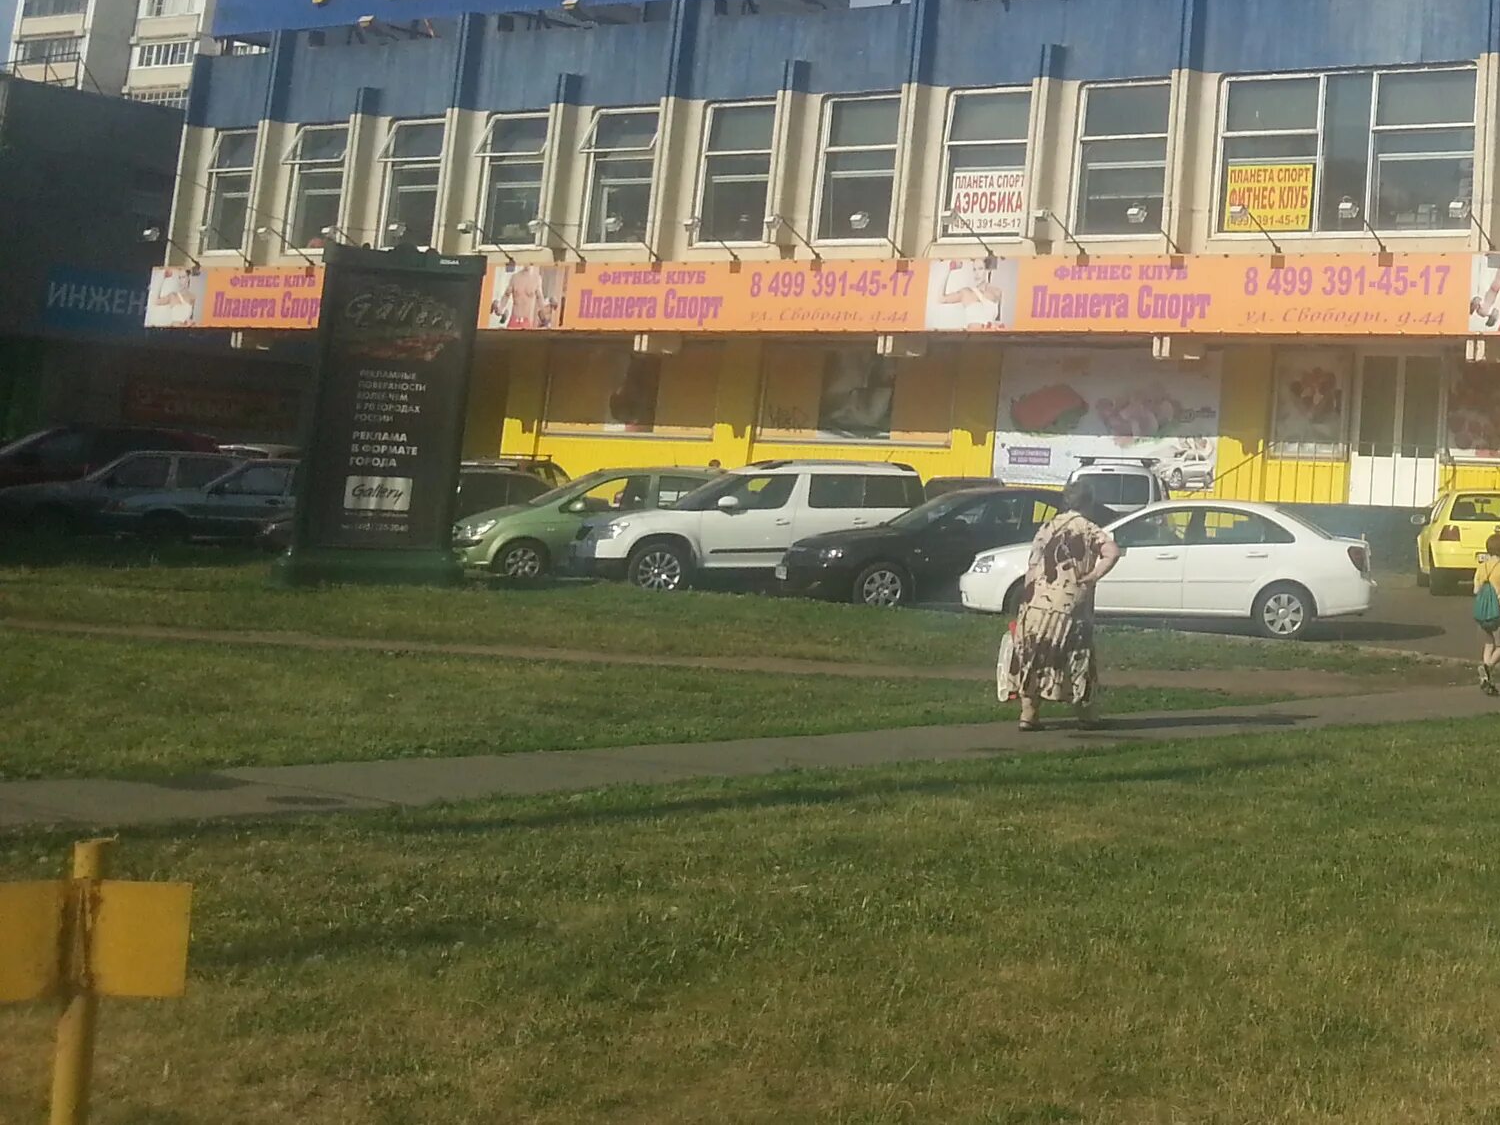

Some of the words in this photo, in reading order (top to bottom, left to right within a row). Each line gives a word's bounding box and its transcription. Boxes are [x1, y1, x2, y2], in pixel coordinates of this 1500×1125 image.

[955, 175, 995, 189] ПЛАНЕТА
[996, 174, 1025, 188] СПОРТ
[1230, 168, 1275, 183] ПЛАНЕТА
[1277, 168, 1310, 182] СПОРТ
[954, 191, 1023, 214] АЭРОБИКА
[1229, 186, 1276, 210] ФИТНЕС
[1278, 186, 1309, 209] КЛУБ
[976, 218, 1022, 229] 391-45-17
[1256, 214, 1307, 226] 391-45-17
[230, 274, 280, 288] ФИТНЕС
[283, 274, 317, 288] КЛУБ
[598, 270, 660, 285] ФИТНЕС
[665, 270, 706, 285] КЛУБ
[1053, 264, 1132, 281] ФИТНЕС
[1138, 264, 1188, 281] КЛУБ
[1243, 266, 1259, 296] 8
[1266, 266, 1313, 296] 499
[1321, 265, 1451, 296] 391-45-17
[750, 271, 762, 298] 8
[768, 271, 806, 298] 499
[811, 270, 914, 298] 391-45-17
[47, 281, 147, 316] ИНЖЕН
[578, 288, 657, 319] Планета
[663, 288, 723, 326] Спорт
[1030, 285, 1130, 319] Планета
[1137, 284, 1212, 327] Спорт
[213, 291, 276, 319] Планета
[280, 291, 320, 324] Спор
[353, 431, 408, 442] РЕКЛАМА
[362, 444, 419, 456] ФОРМАТЕ
[350, 456, 397, 467] ГОРОДА
[351, 483, 403, 505] Gallery
